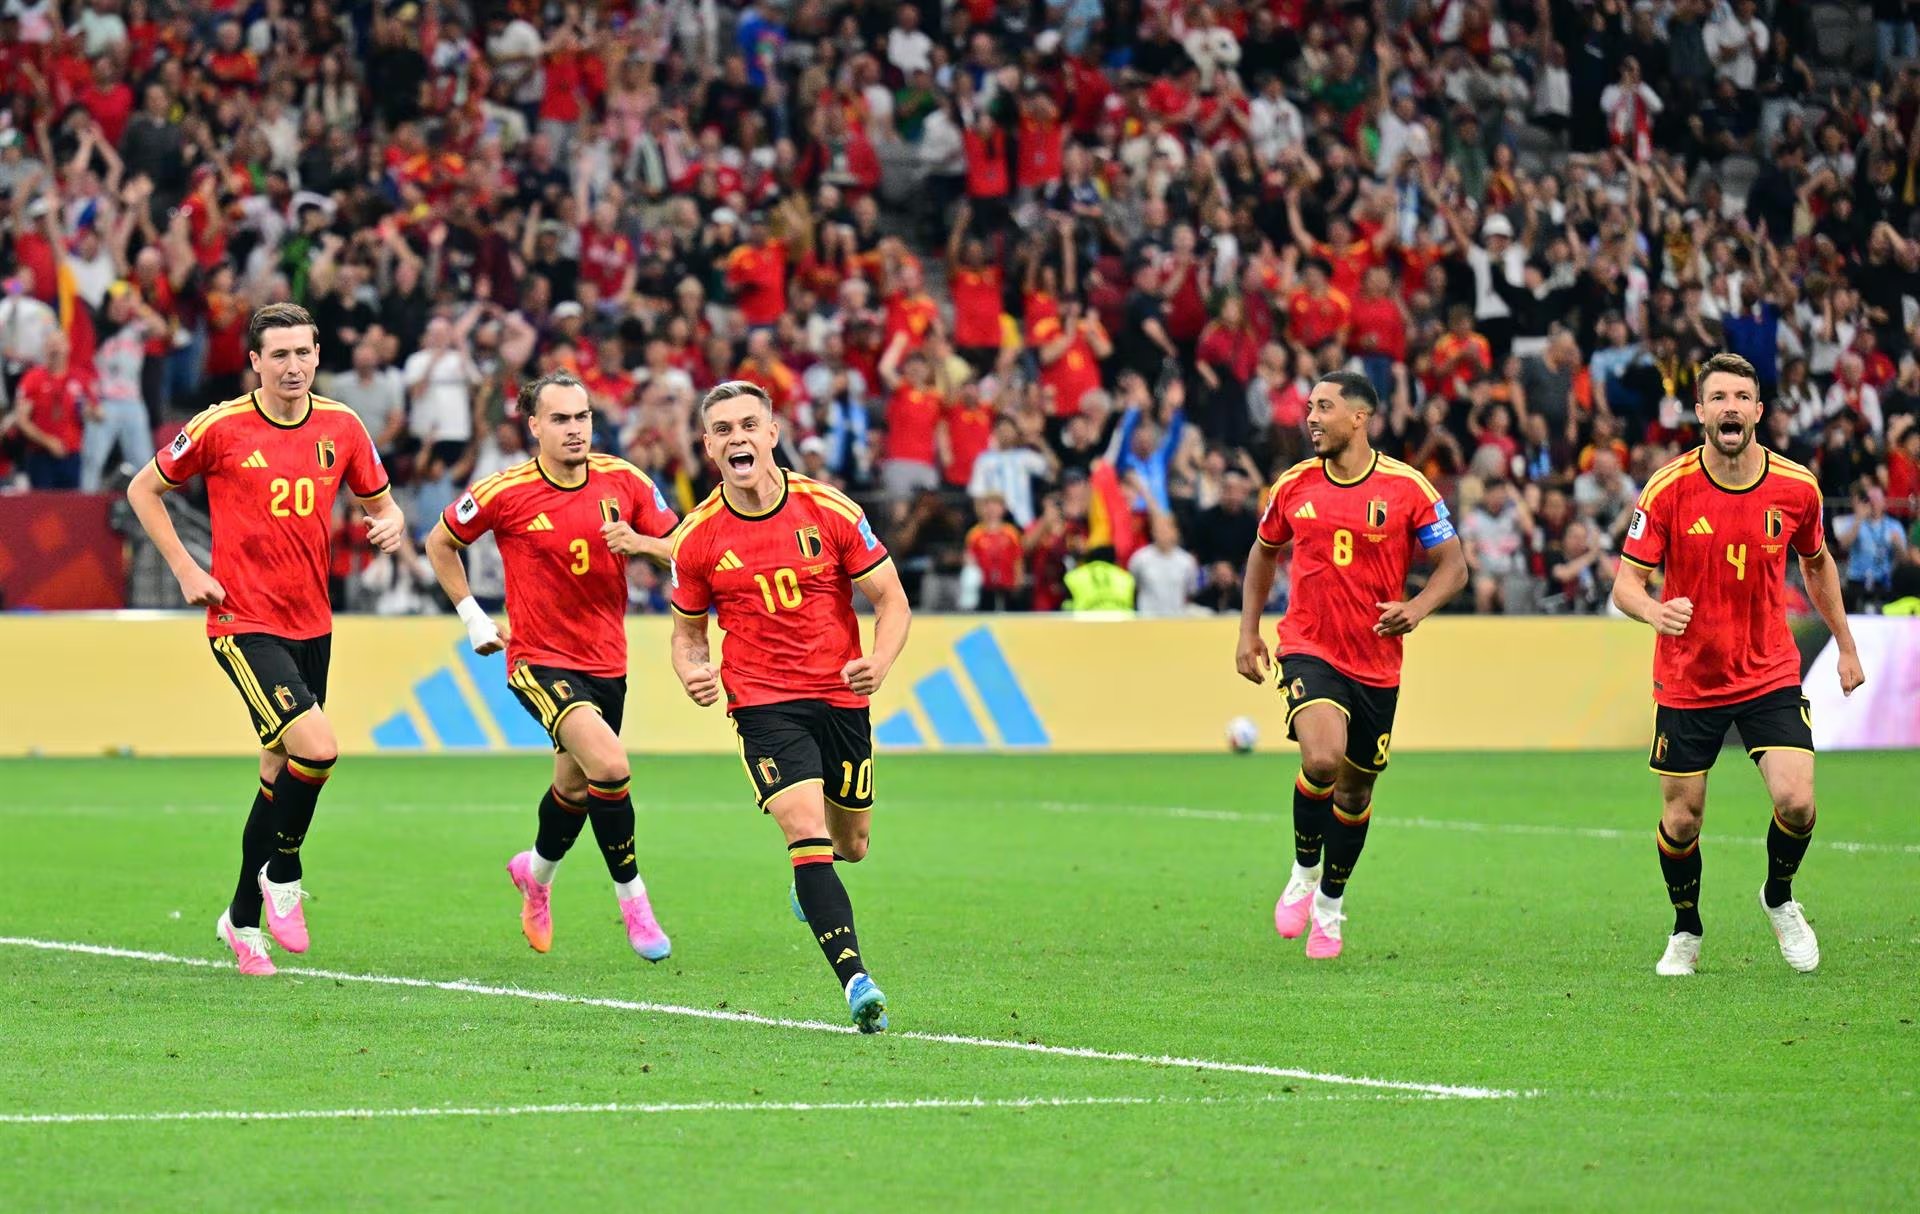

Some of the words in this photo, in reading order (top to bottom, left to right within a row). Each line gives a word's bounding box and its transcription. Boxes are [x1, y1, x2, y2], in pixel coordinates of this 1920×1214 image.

[270, 477, 315, 518] 20
[568, 538, 590, 576] 3
[1333, 529, 1354, 567] 8
[1726, 543, 1747, 581] 4
[753, 567, 803, 614] 10
[1373, 733, 1390, 765] 8
[839, 758, 871, 799] 10
[819, 925, 851, 945] RBFA
